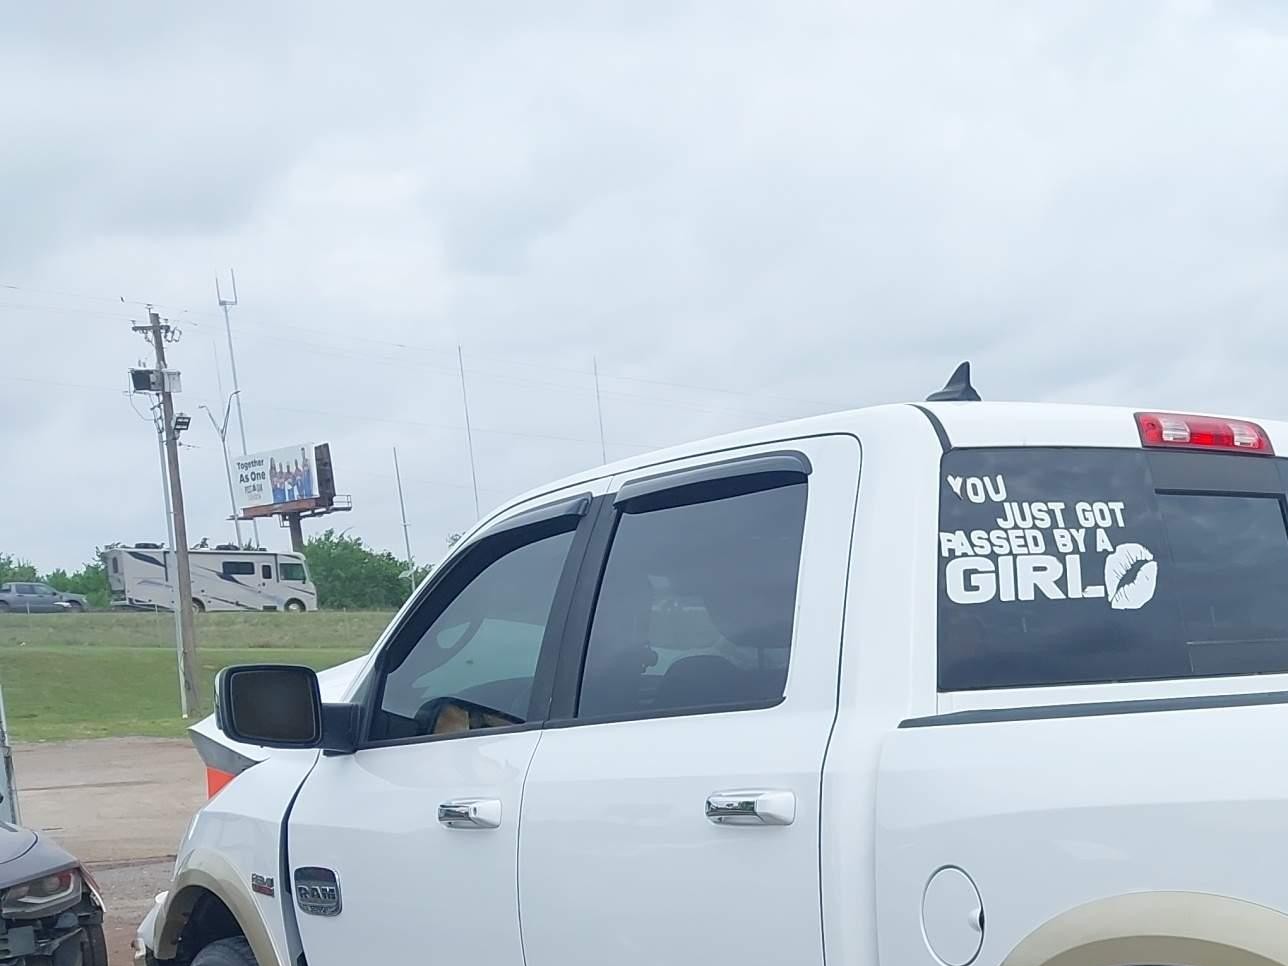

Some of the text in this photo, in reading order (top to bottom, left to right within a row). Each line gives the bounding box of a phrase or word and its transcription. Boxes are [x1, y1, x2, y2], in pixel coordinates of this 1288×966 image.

[236, 459, 264, 471] Together
[240, 471, 266, 482] As One
[947, 474, 1007, 504] YOU
[997, 502, 1125, 529] JUST GOT
[940, 528, 1114, 557] PASSED BY A
[945, 554, 1105, 605] GIRL
[297, 886, 337, 900] RAM
